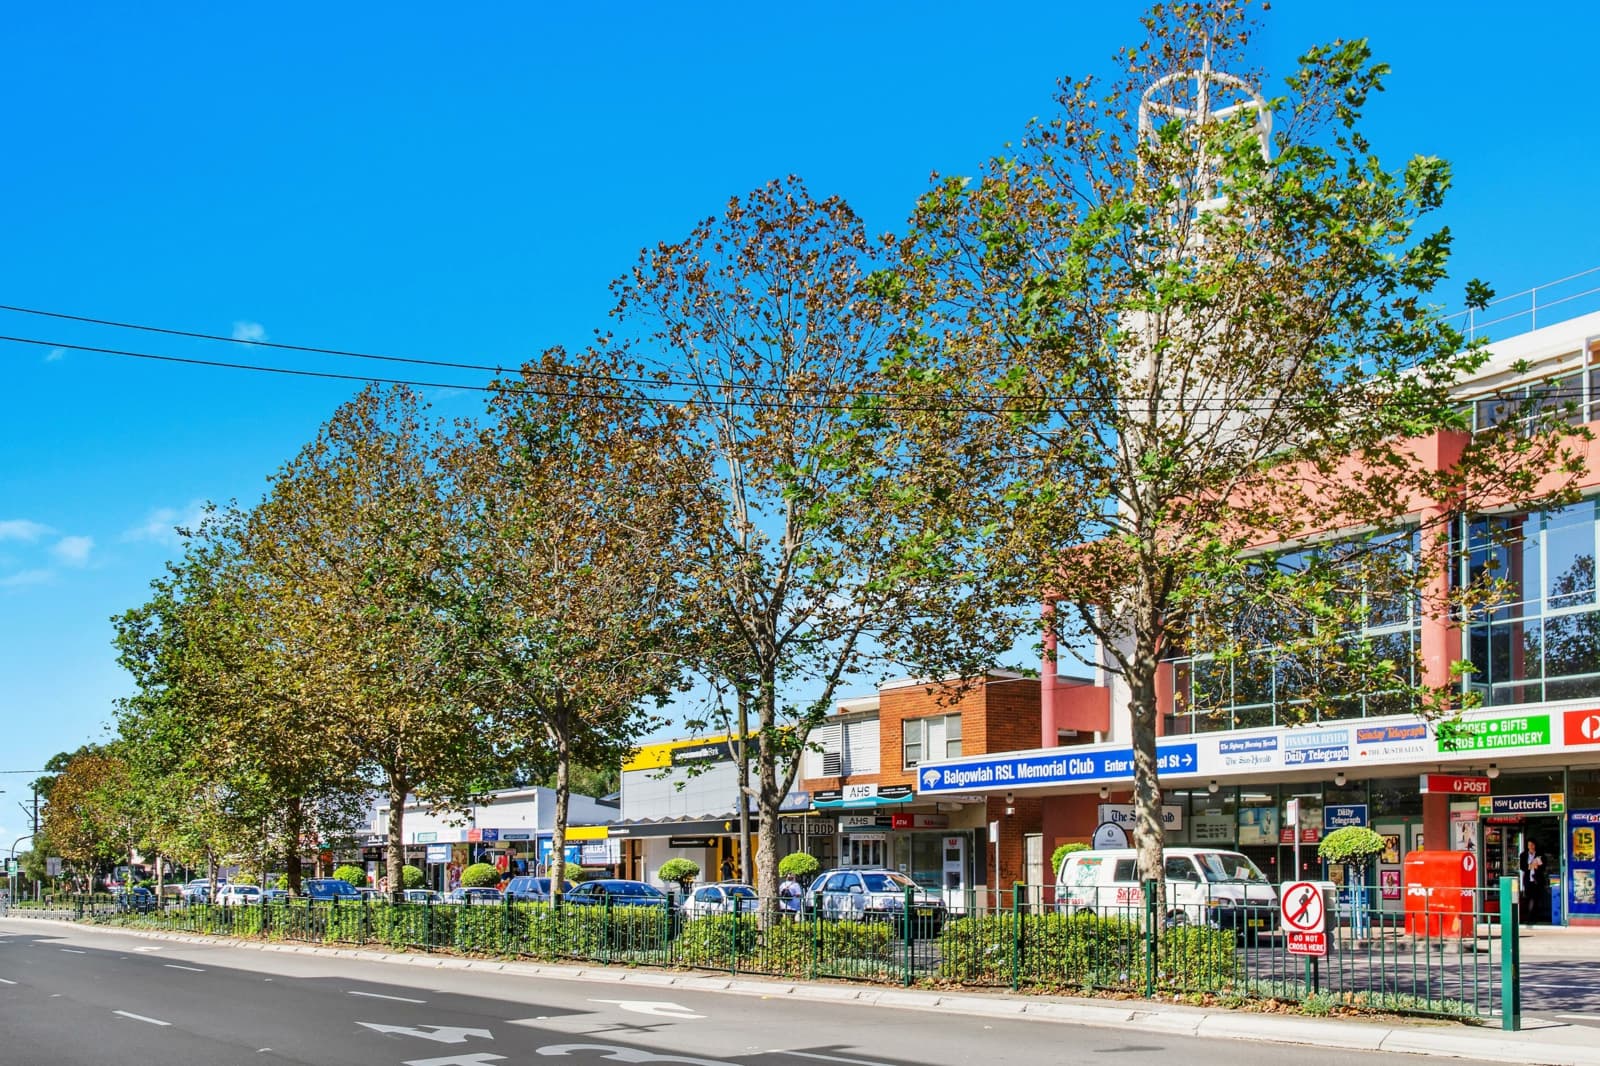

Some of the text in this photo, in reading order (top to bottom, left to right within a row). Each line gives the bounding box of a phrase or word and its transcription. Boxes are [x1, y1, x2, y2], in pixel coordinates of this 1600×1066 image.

[1501, 719, 1528, 731] GIFTS
[1358, 726, 1425, 742] Sunday Telegraph
[1477, 735, 1484, 747] &
[1486, 732, 1544, 746] STATIONERY
[1285, 747, 1348, 763] Daily Telegraph
[944, 767, 993, 786] Balgowlah
[996, 764, 1014, 780] RSL
[1018, 760, 1066, 779] Memorial
[1069, 758, 1094, 775] Club
[1104, 760, 1128, 772] Enter
[1169, 754, 1180, 768] St
[850, 786, 870, 798] AHS
[1464, 782, 1488, 792] POST
[1508, 799, 1548, 810] Lotteries
[1110, 810, 1128, 822] The
[1338, 808, 1354, 817] Daily
[848, 817, 868, 825] AHS
[1330, 816, 1360, 826] Telegraph
[1578, 832, 1592, 844] 15
[1408, 888, 1434, 896] POST
[1289, 942, 1307, 950] CROSS
